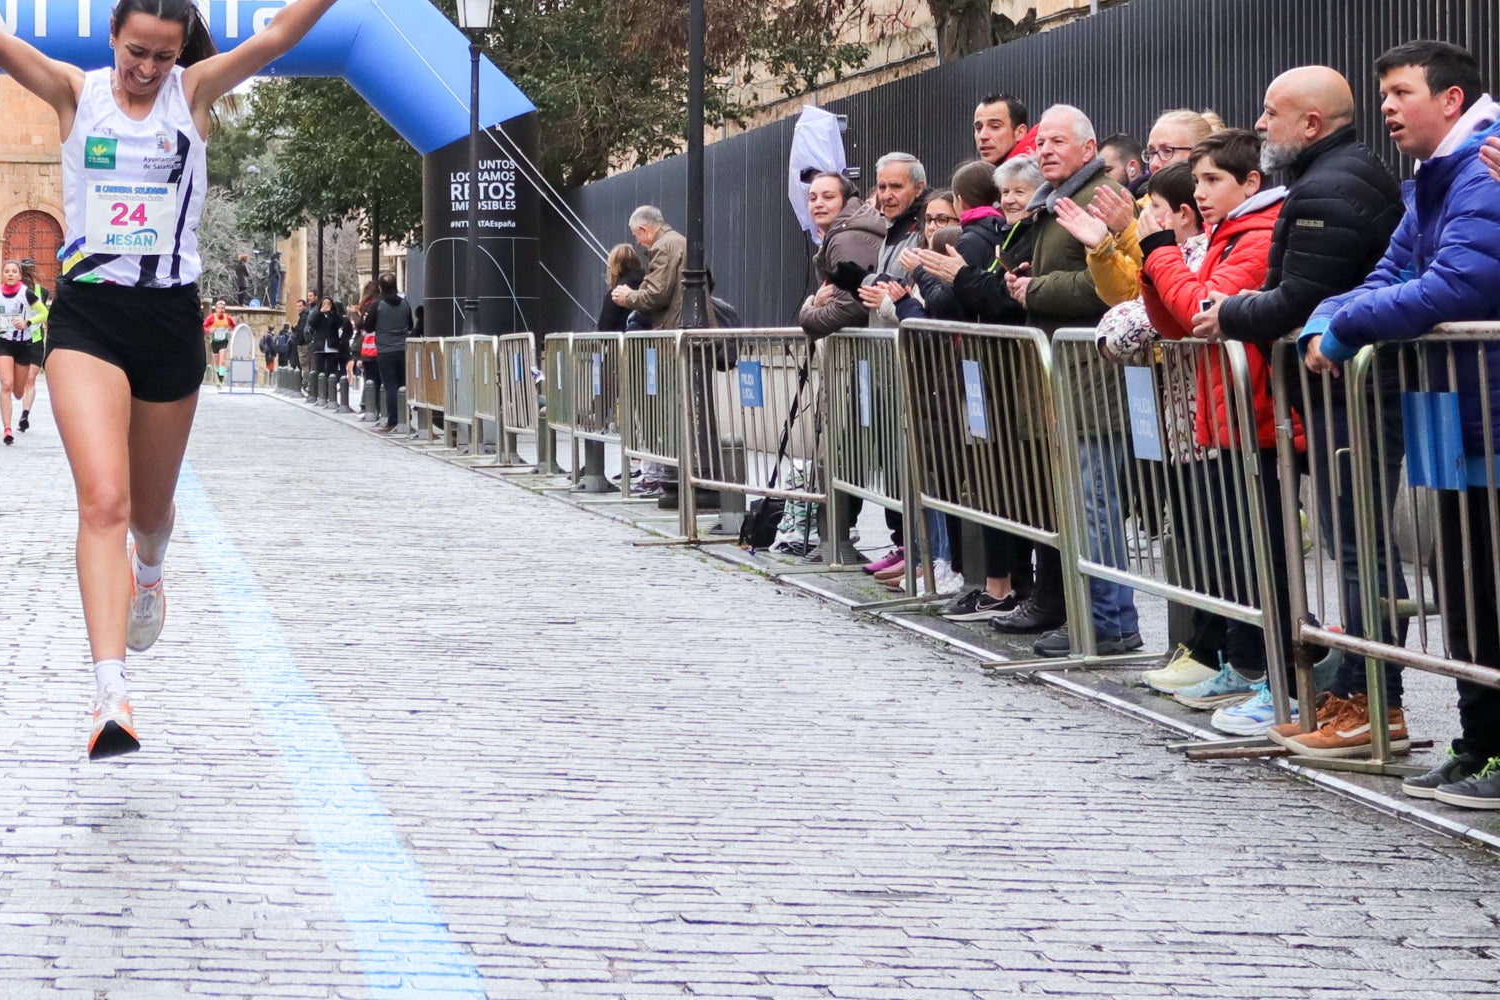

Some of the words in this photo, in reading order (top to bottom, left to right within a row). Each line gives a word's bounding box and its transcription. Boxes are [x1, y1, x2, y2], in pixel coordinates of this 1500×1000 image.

[477, 159, 516, 170] UNTOS
[451, 200, 517, 212] IMSIBLES
[110, 202, 148, 227] 24
[450, 220, 517, 229] #NTTTAEspaña
[105, 233, 153, 246] HESAN
